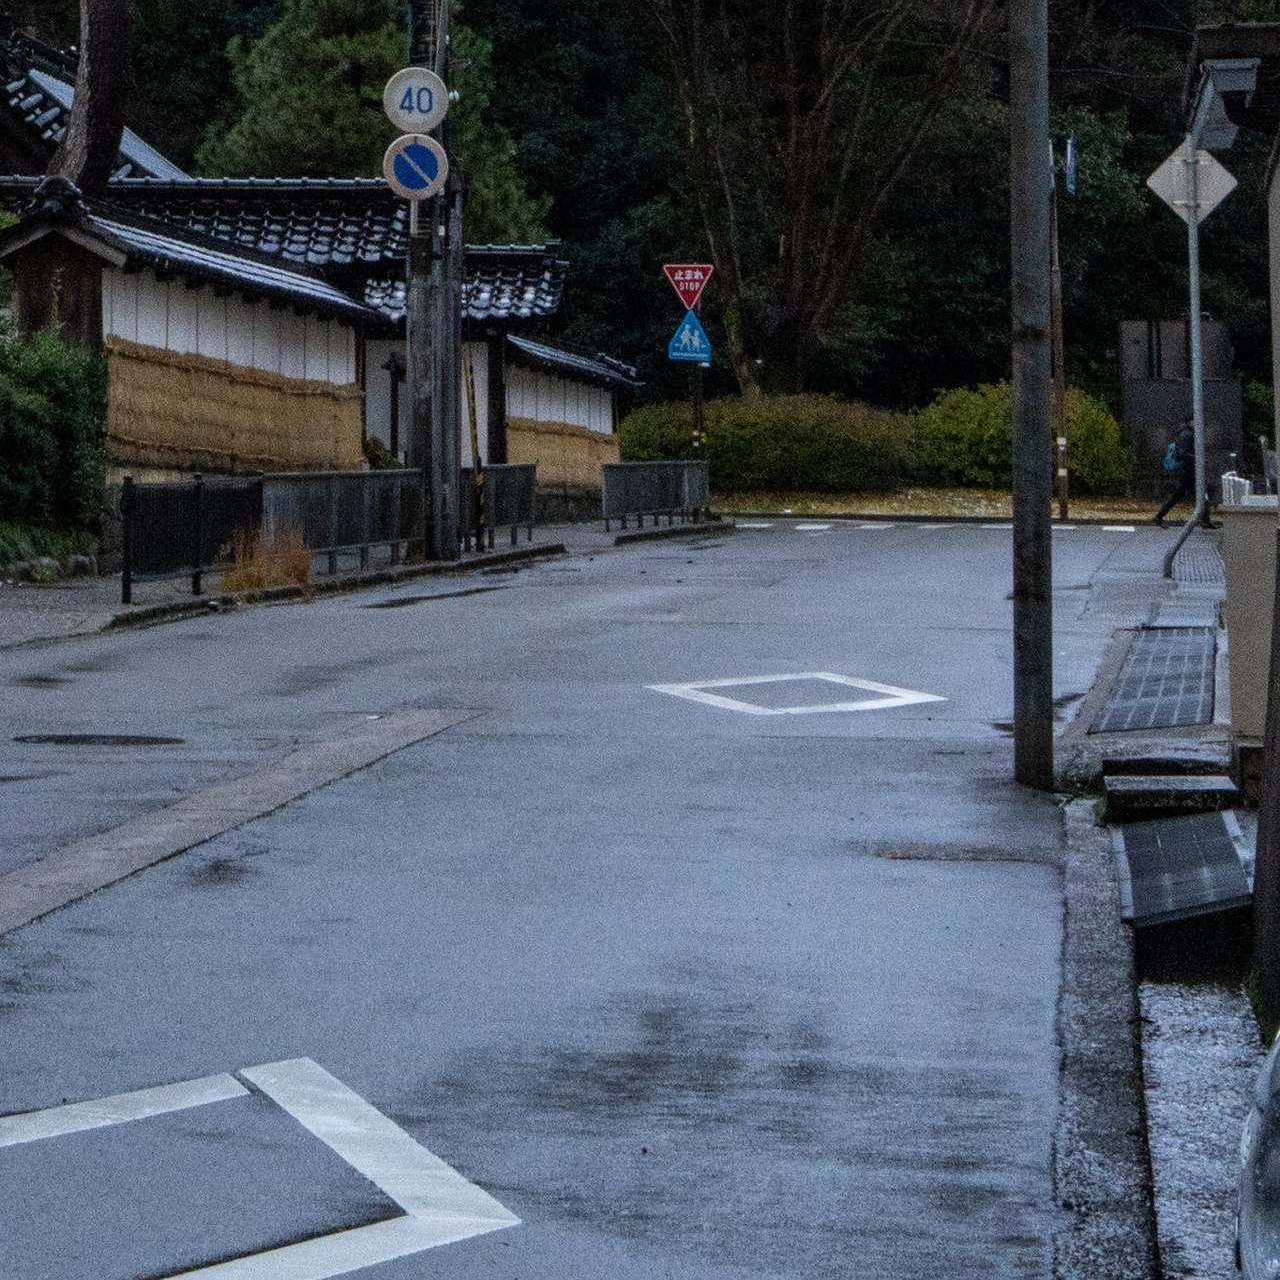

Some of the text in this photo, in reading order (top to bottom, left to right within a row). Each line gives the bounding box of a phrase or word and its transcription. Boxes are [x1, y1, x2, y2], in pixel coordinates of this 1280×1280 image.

[399, 87, 433, 114] 40
[674, 269, 704, 281] 止まれ
[679, 281, 701, 291] STOP
